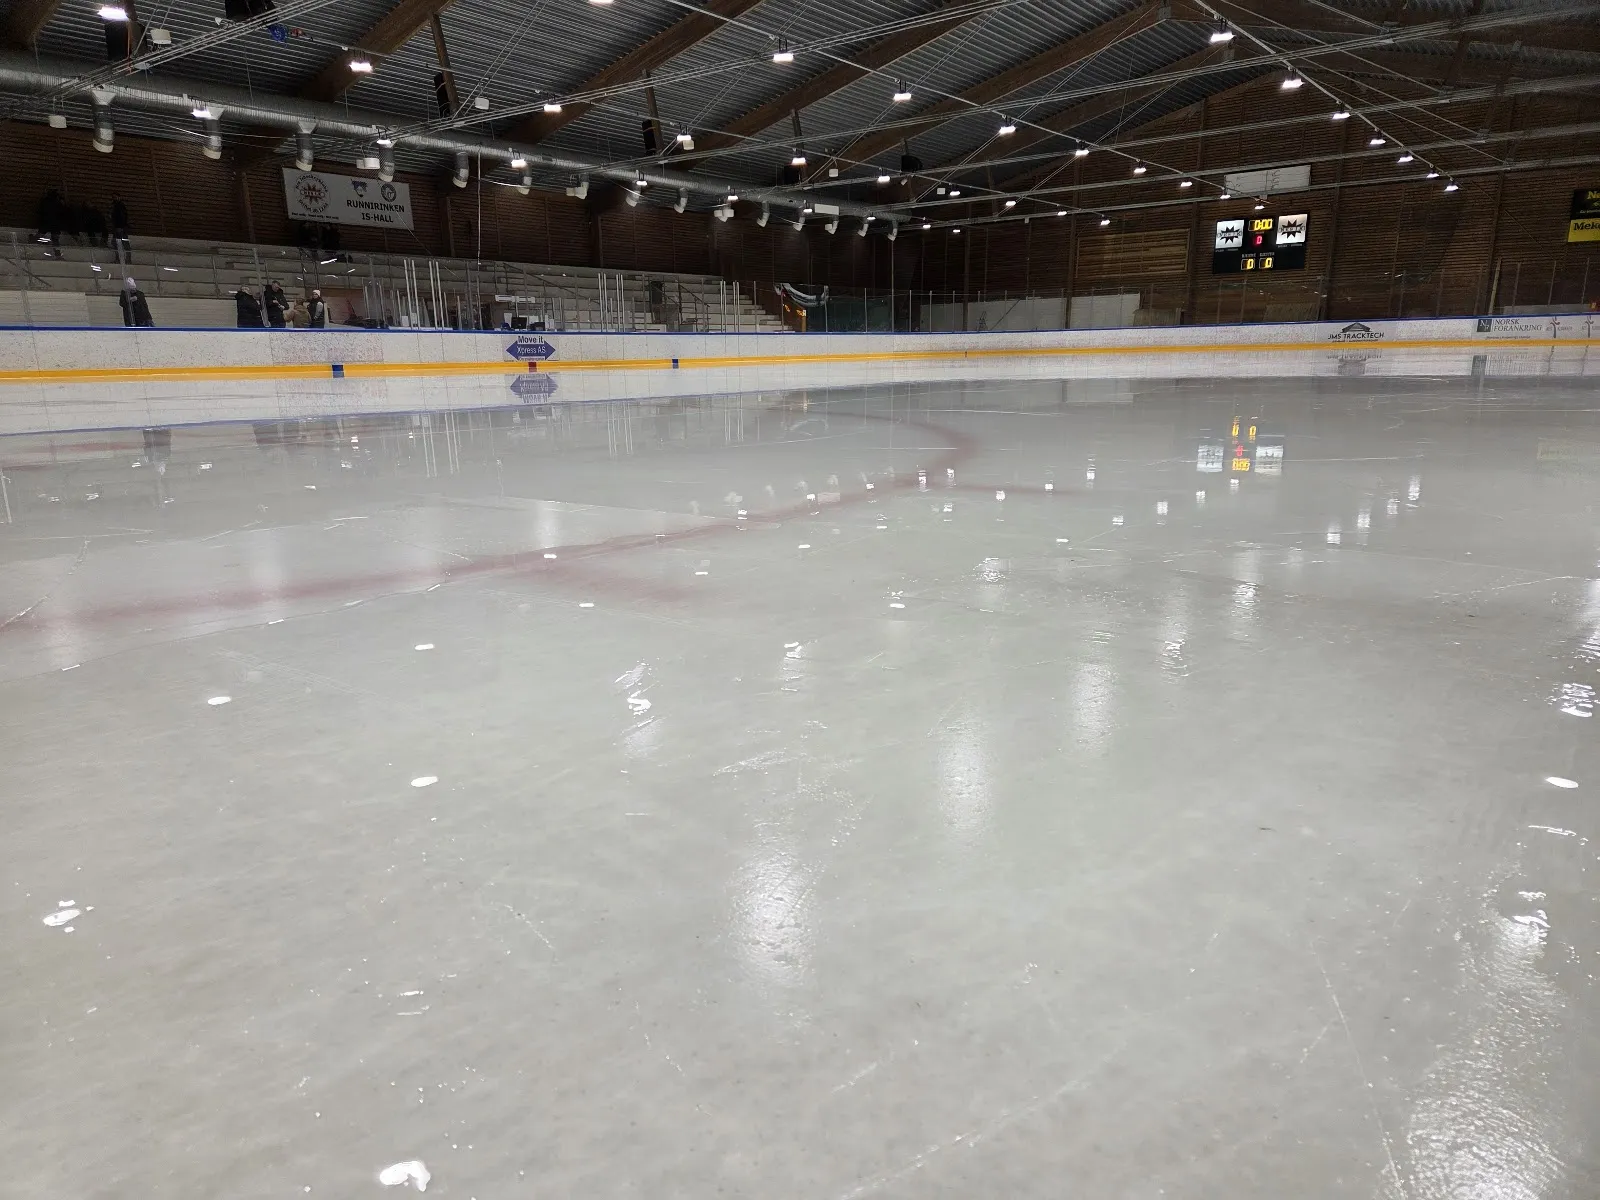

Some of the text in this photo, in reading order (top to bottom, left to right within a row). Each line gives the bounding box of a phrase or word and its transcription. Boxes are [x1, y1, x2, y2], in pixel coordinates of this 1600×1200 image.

[346, 199, 405, 213] RUNNIRINKEN
[361, 212, 394, 223] IS-HALL
[1493, 323, 1543, 332] FORANKRING
[518, 335, 543, 343] Move it
[517, 345, 546, 355] Xpress AS
